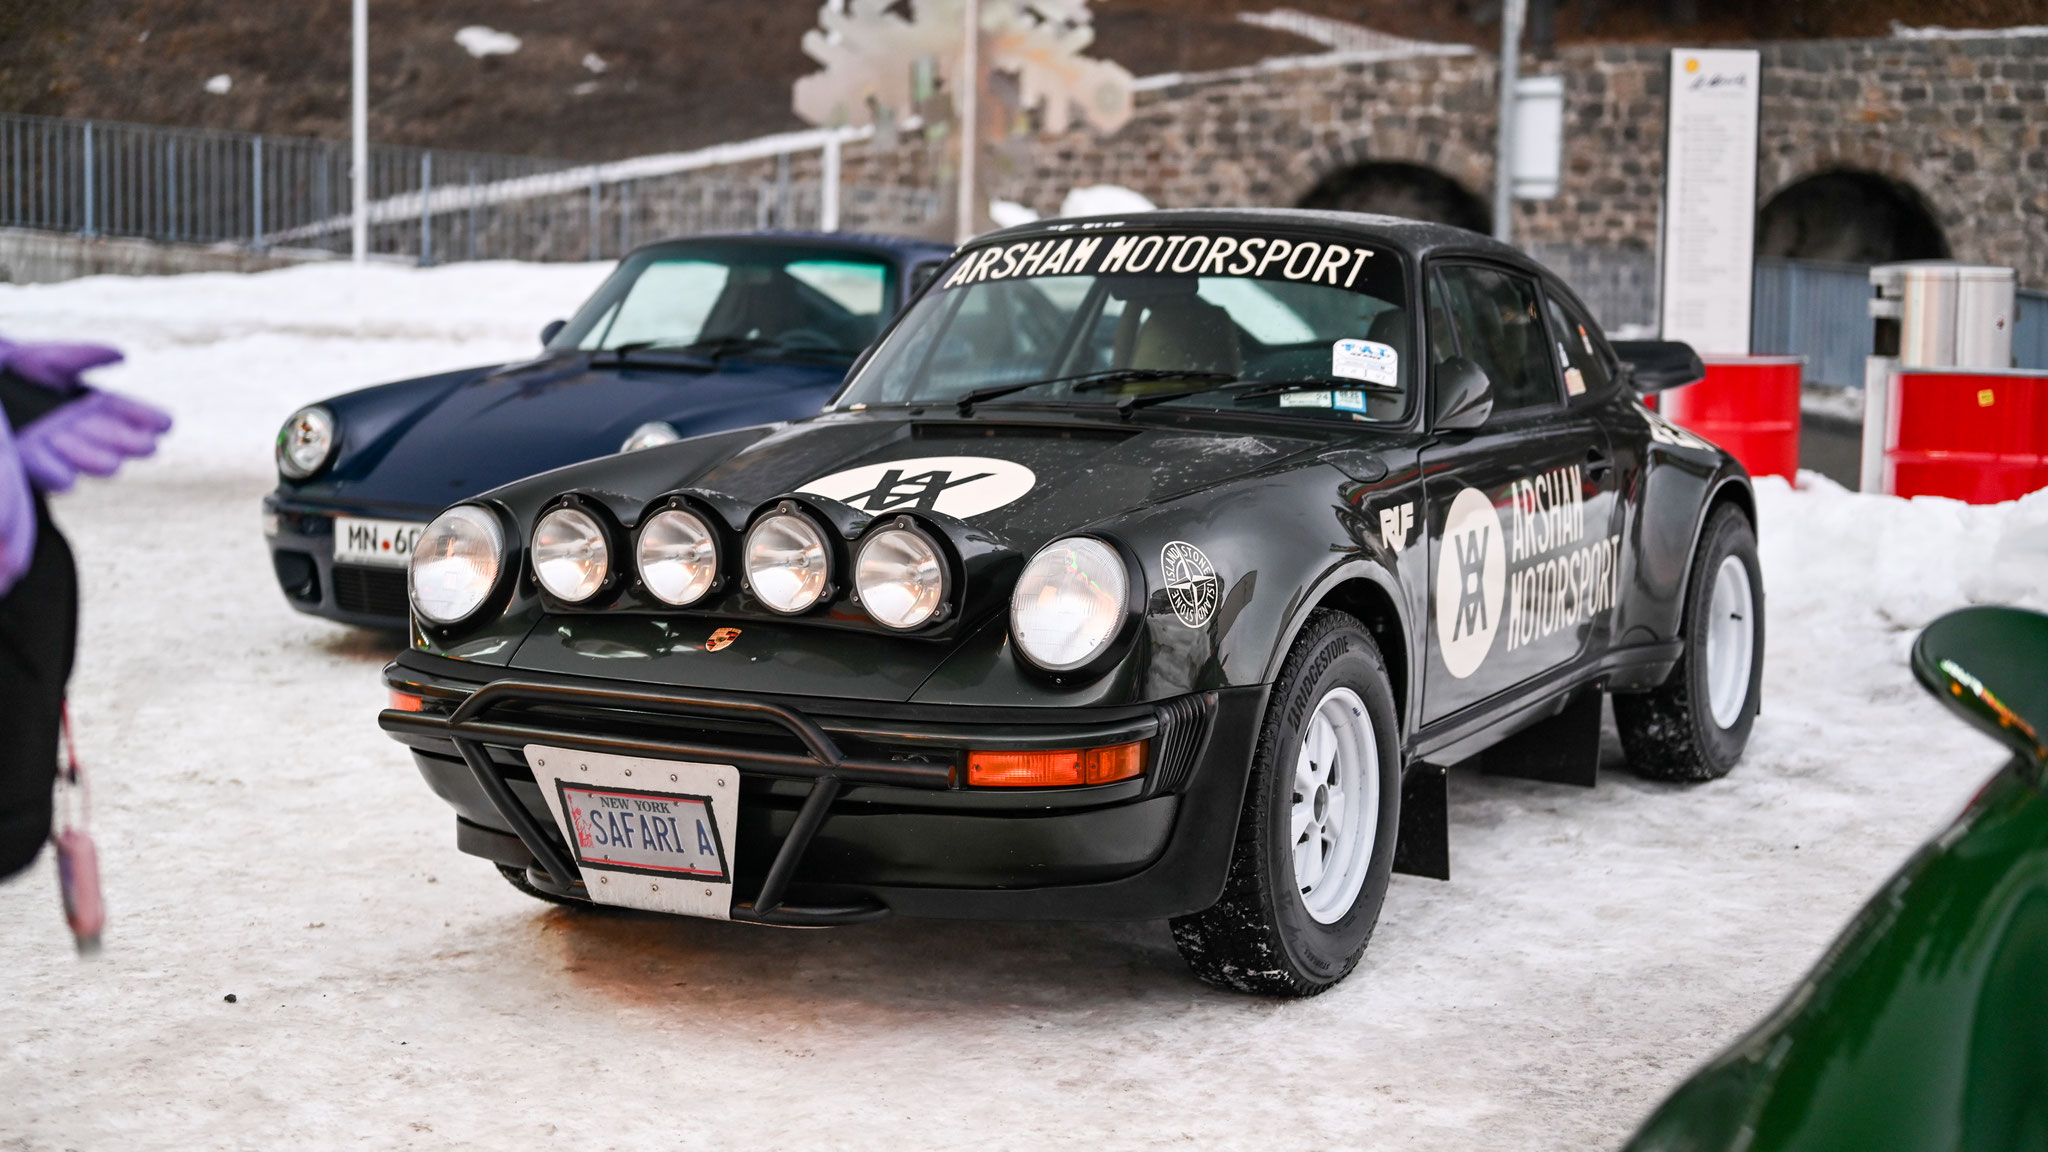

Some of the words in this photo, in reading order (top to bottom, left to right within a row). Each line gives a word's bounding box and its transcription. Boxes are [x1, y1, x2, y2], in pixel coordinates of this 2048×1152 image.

[943, 236, 1102, 289] ARSHAM
[1098, 235, 1375, 288] MOTORSPORT
[348, 525, 378, 551] MN
[1380, 502, 1414, 552] RUF
[1511, 464, 1583, 564] ARSHAM
[1165, 547, 1180, 581] ISLAND
[1180, 545, 1211, 575] STONE
[1198, 583, 1215, 620] ISLAND
[1171, 590, 1194, 622] STONE
[1507, 534, 1620, 652] MOTORSPORT
[1287, 635, 1350, 734] BRIDGESTONE
[600, 796, 630, 811] NEW
[634, 800, 671, 814] YORK
[590, 809, 685, 853] SAFARI
[696, 819, 715, 856] A
